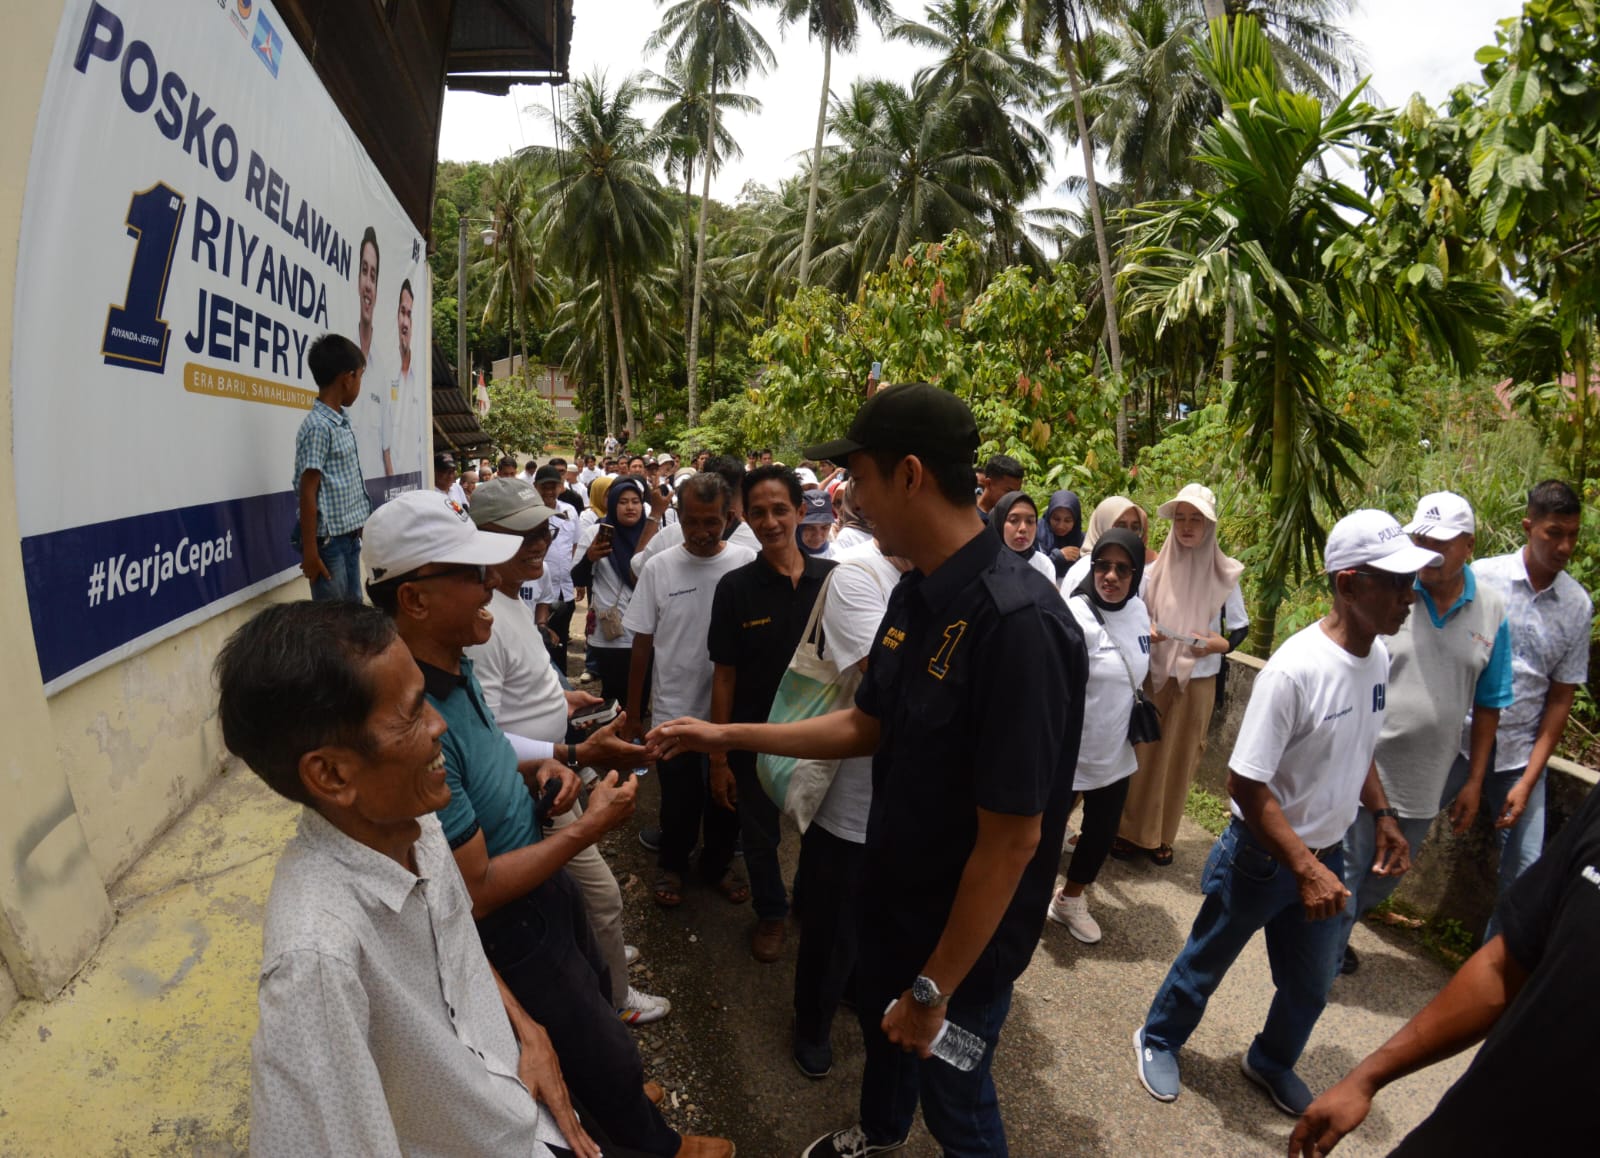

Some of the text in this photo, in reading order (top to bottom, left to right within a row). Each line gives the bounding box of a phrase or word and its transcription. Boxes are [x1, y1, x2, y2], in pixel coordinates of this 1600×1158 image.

[73, 1, 352, 281] POSKO RELAWAN
[100, 180, 184, 374] 1
[192, 196, 328, 329] RIYANDA
[111, 326, 160, 347] RIYANDA JEFFRY
[185, 287, 308, 380] JEFFRY
[193, 371, 214, 389] ERA
[217, 376, 249, 396] BARU,
[251, 383, 306, 405] SAWAHLUNTO
[88, 529, 233, 607] #KerjaCepat
[927, 620, 968, 680] 1
